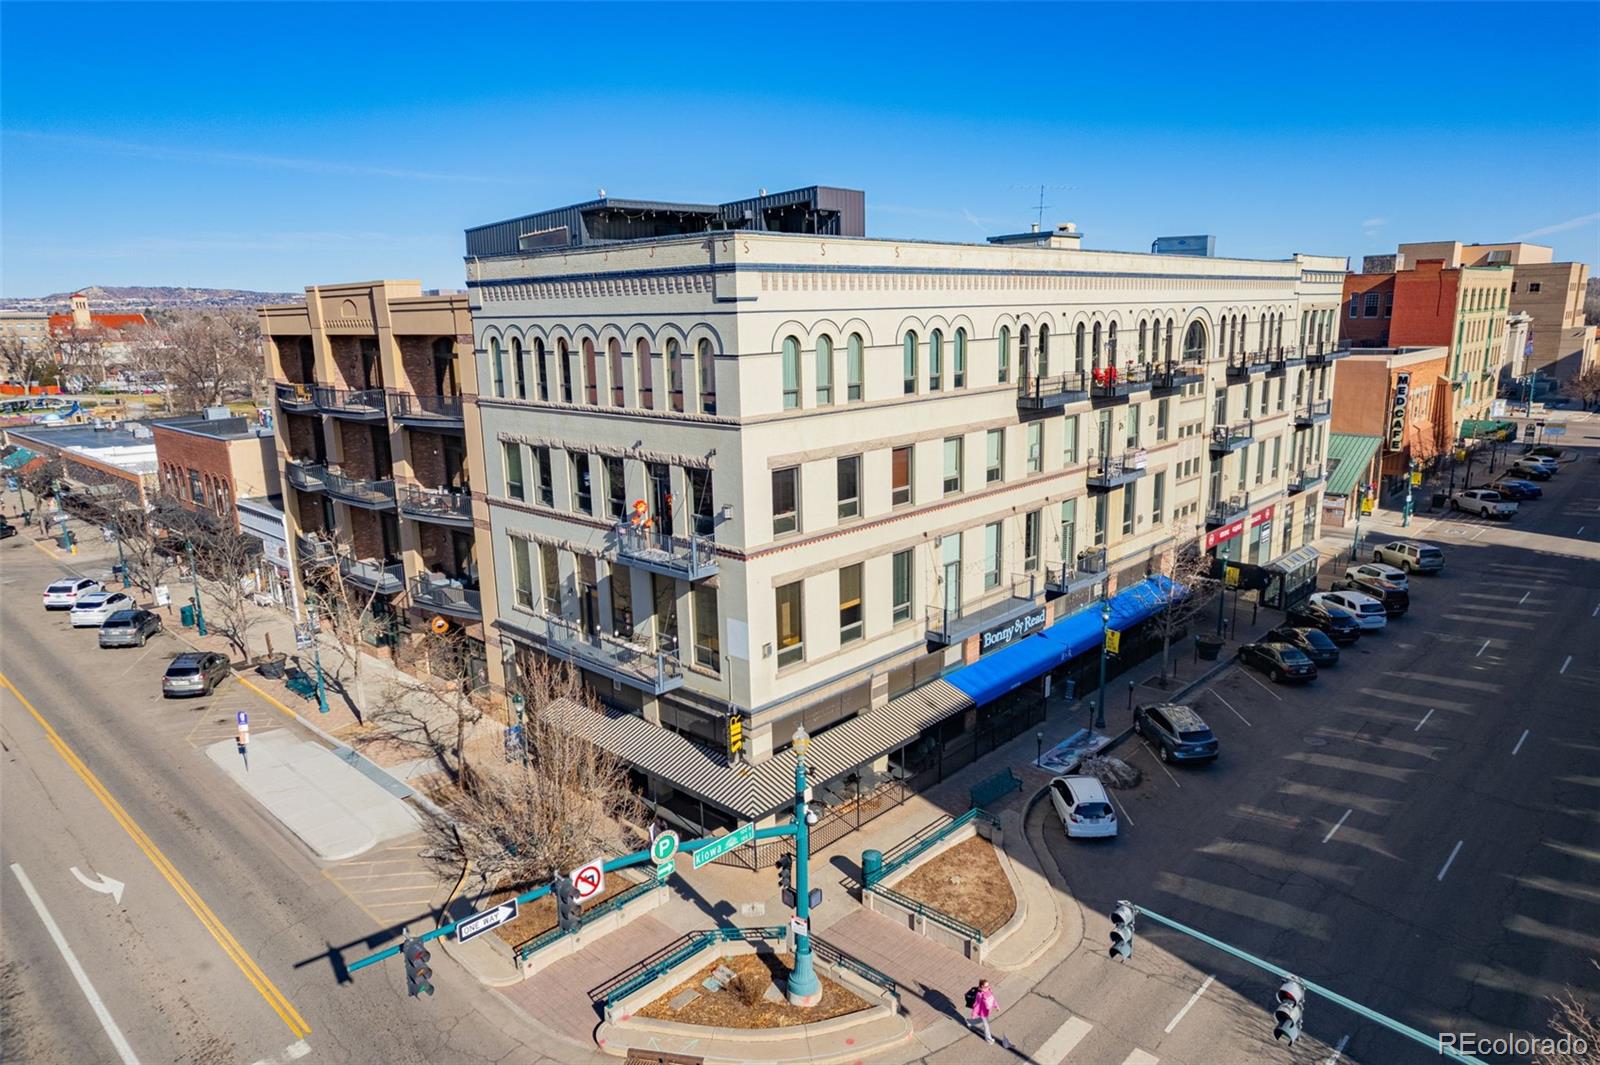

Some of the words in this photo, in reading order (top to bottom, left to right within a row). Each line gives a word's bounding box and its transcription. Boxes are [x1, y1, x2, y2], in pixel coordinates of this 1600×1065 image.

[983, 625, 1014, 648] Bonny
[1023, 609, 1045, 632] Read
[659, 839, 670, 857] P
[695, 844, 722, 866] Kiowa
[463, 922, 480, 935] ONE
[482, 912, 499, 926] WAY
